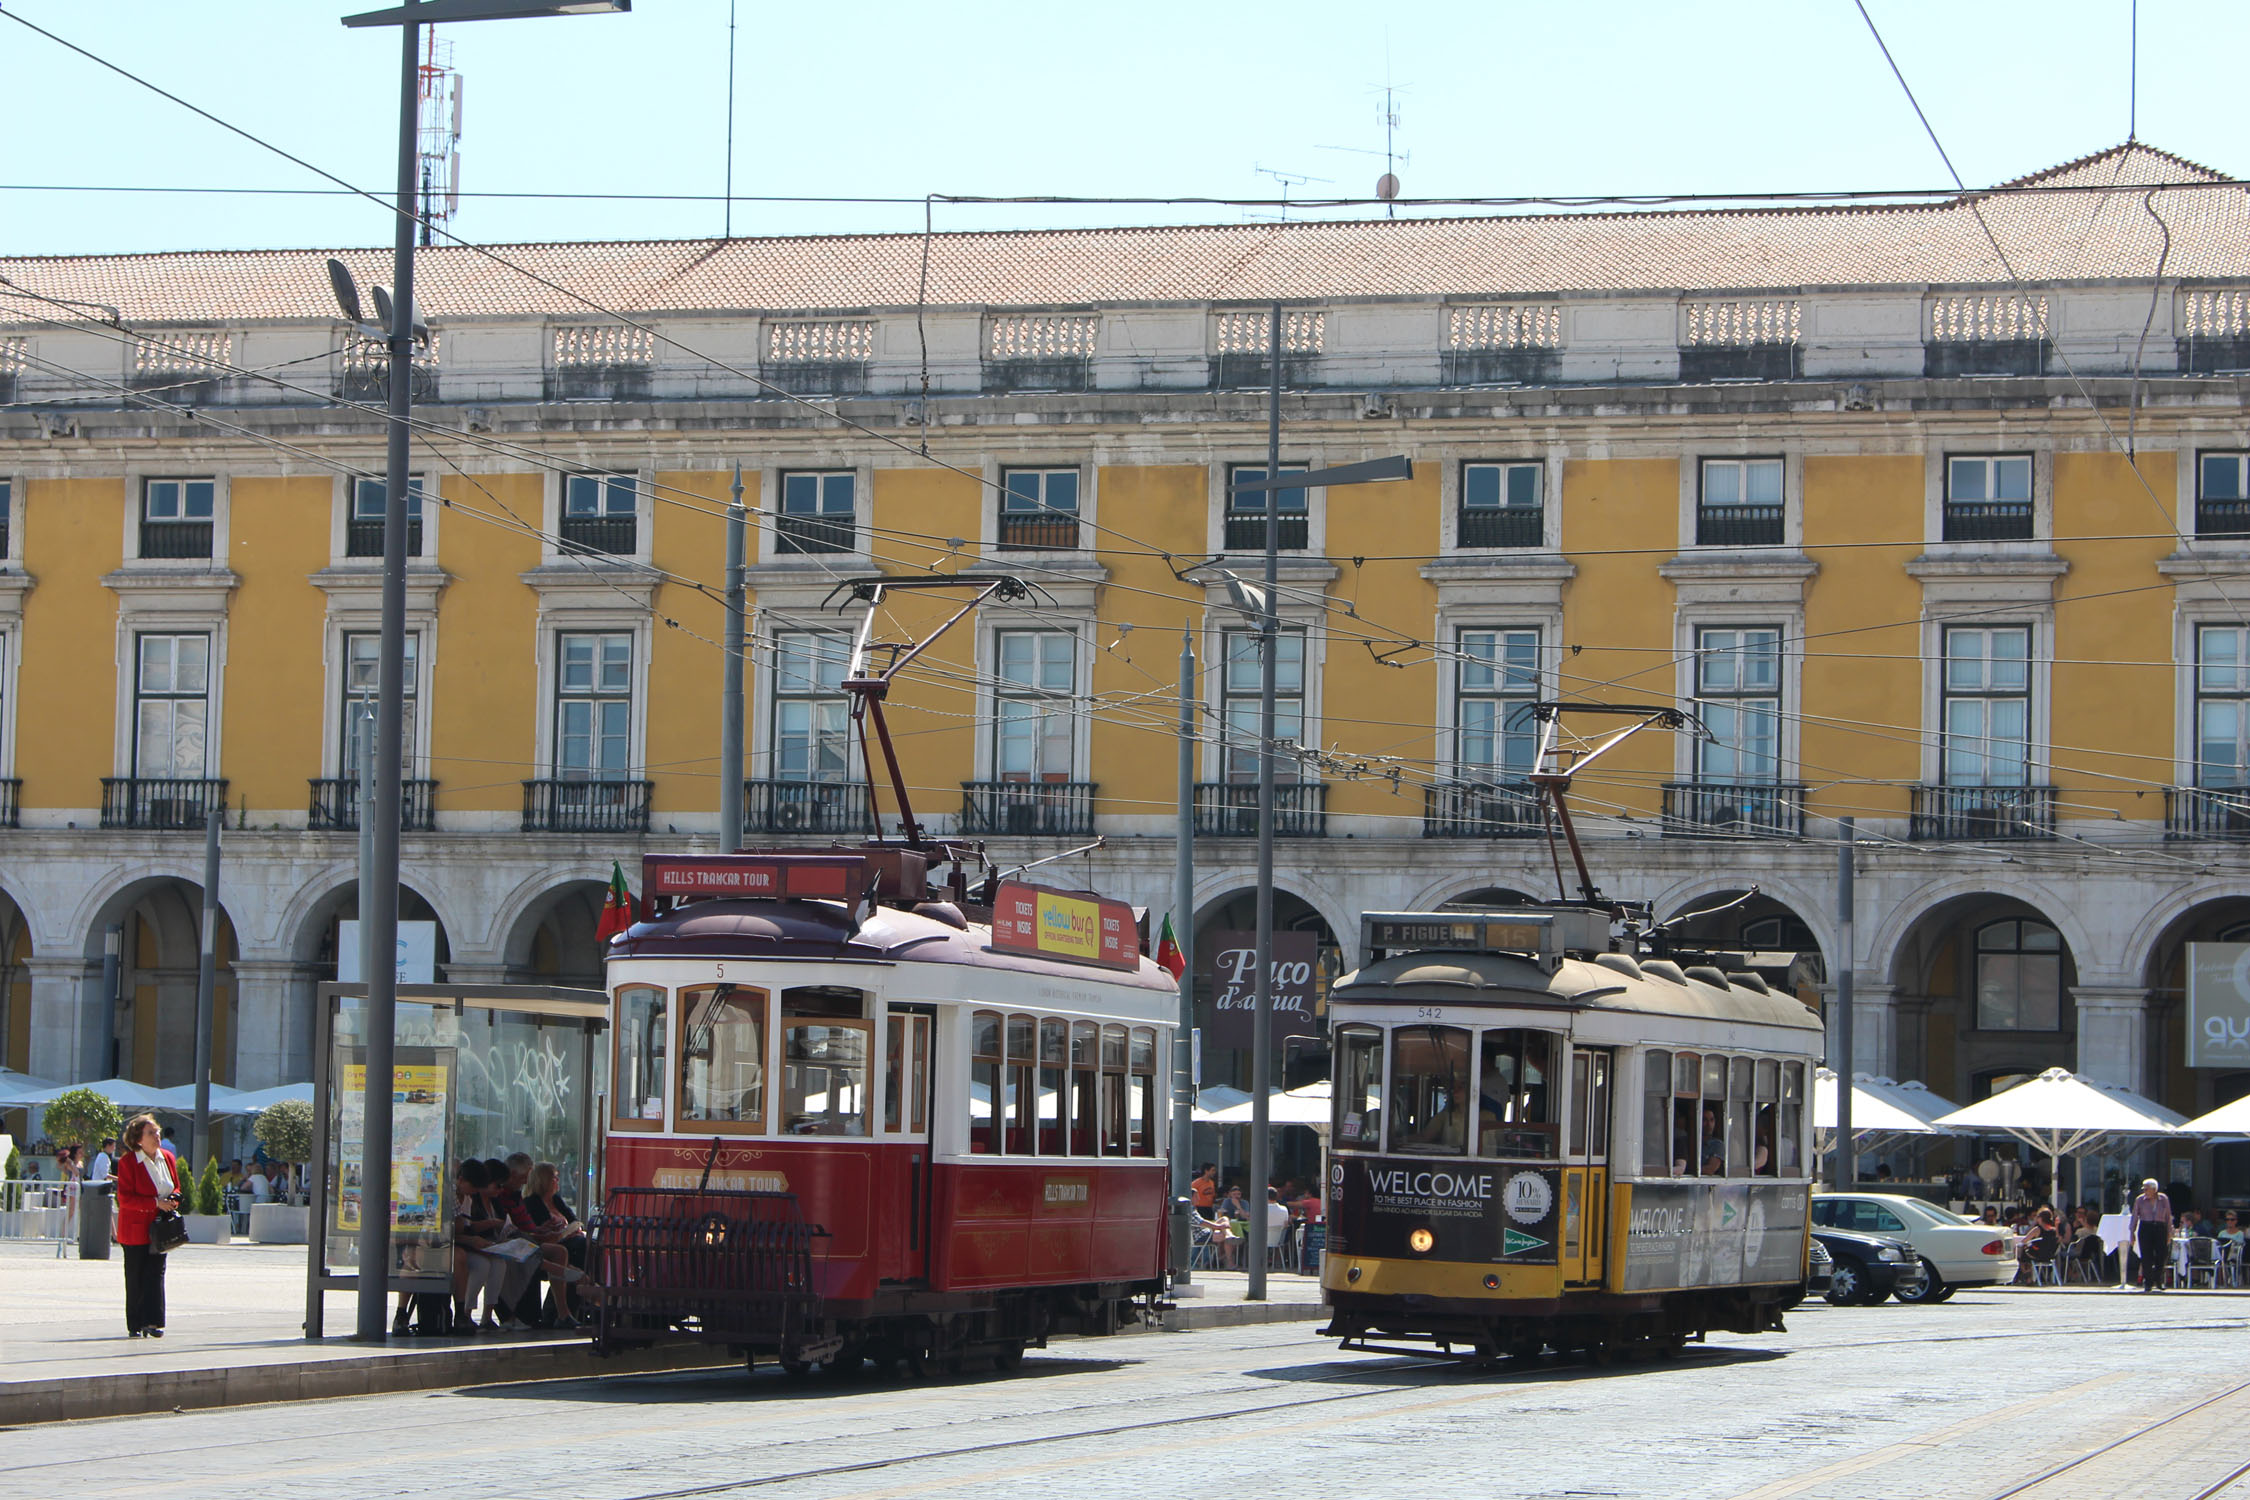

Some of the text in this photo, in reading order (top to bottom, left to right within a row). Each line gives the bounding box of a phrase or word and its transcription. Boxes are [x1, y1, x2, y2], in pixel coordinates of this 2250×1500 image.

[663, 871, 769, 887] HILLS TRAMCAR TOUR
[1015, 901, 1033, 917] TICKETS
[1016, 920, 1032, 935] INSIDE
[1071, 908, 1085, 933] bus
[1103, 917, 1120, 932] TICKETS
[1401, 925, 1476, 941] FIGUEIRA
[1104, 936, 1119, 950] INSIDE
[716, 963, 724, 979] 5
[1417, 1006, 1442, 1019] 542
[660, 1174, 781, 1193] HILLS TAMCAR TOUR
[1368, 1168, 1493, 1199] WELCOME
[1374, 1194, 1483, 1209] TO THE BEST PLACE IN FASHION
[1629, 1207, 1685, 1239] WELCOME
